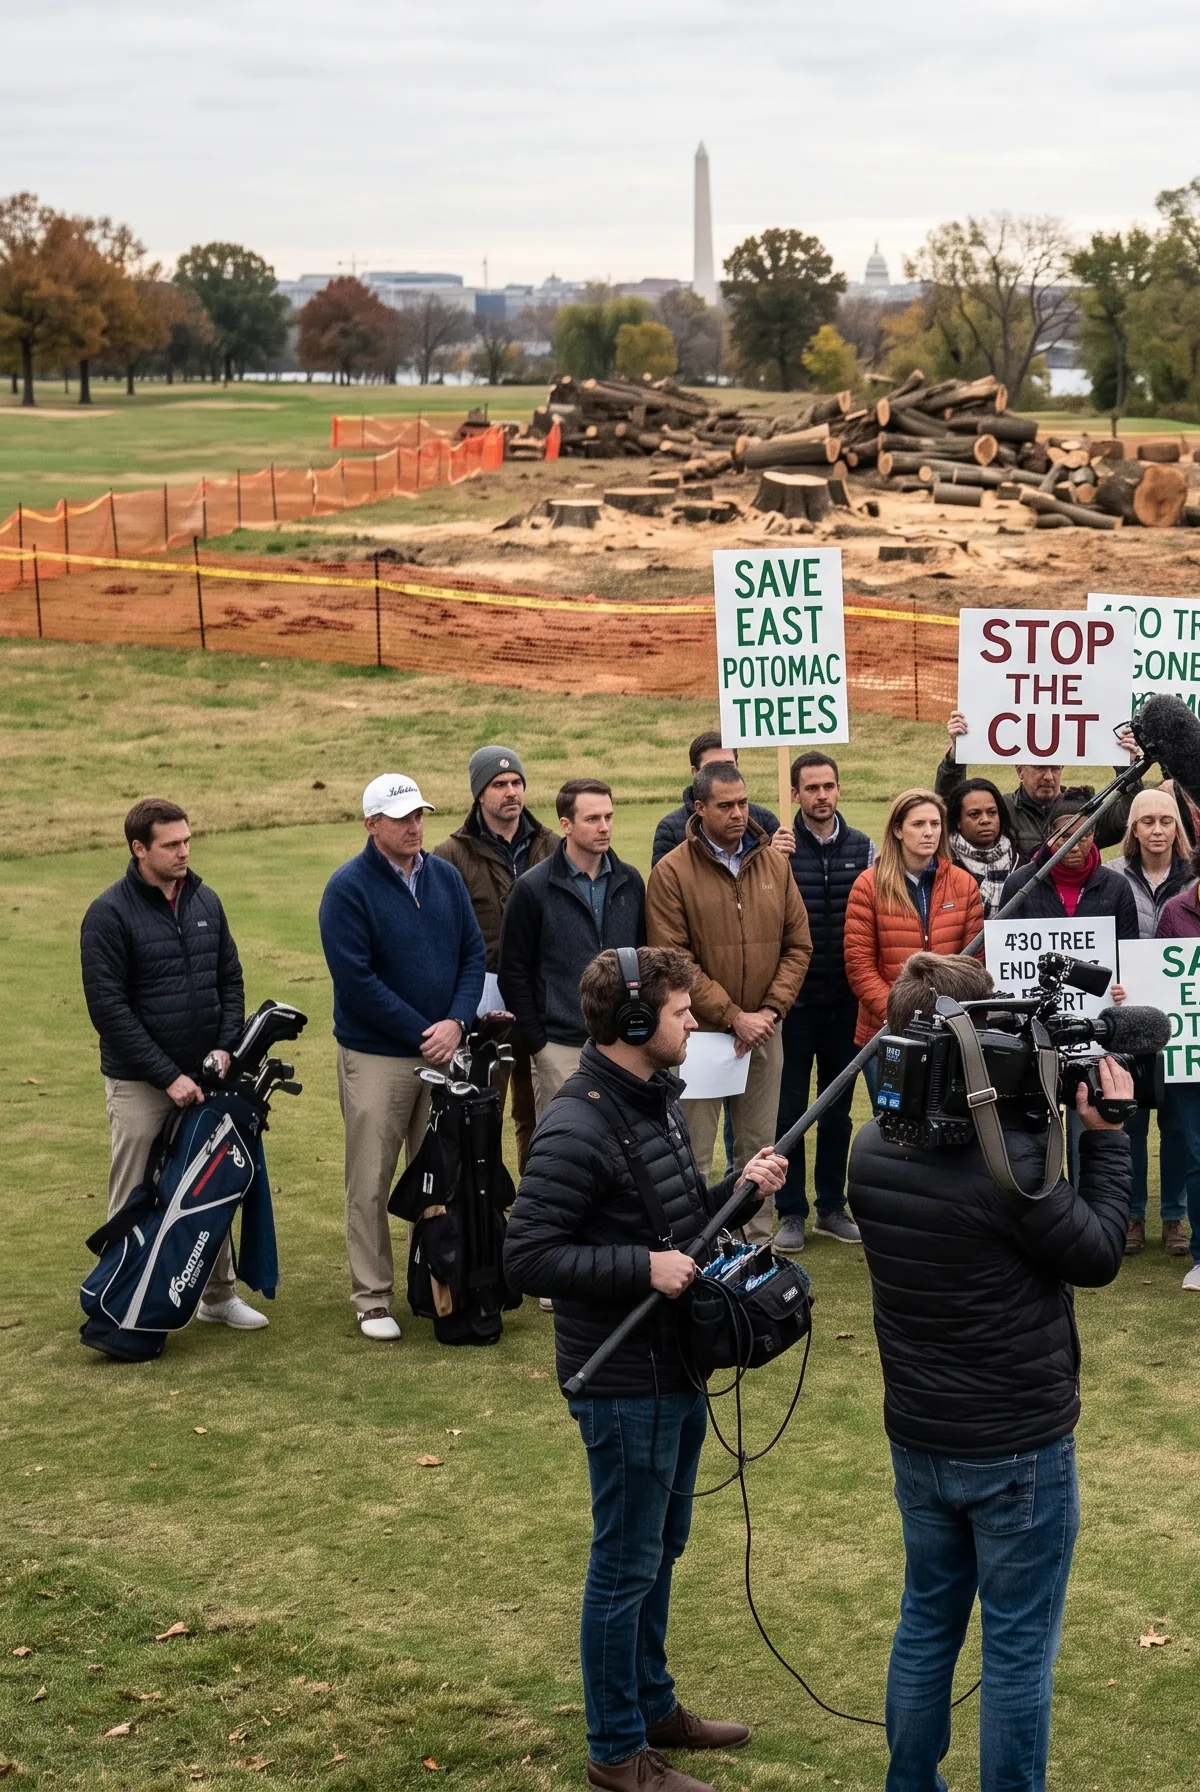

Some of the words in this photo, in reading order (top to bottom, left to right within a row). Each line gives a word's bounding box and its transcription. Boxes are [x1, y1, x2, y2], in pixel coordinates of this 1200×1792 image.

[735, 558, 822, 600] SAVE
[736, 605, 824, 647] EAST
[979, 618, 1114, 666] STOP
[723, 653, 841, 689] POTOMAC
[1007, 674, 1081, 705] THE
[732, 694, 837, 737] TREES
[988, 712, 1098, 757] CUT
[1048, 930, 1096, 950] TREE
